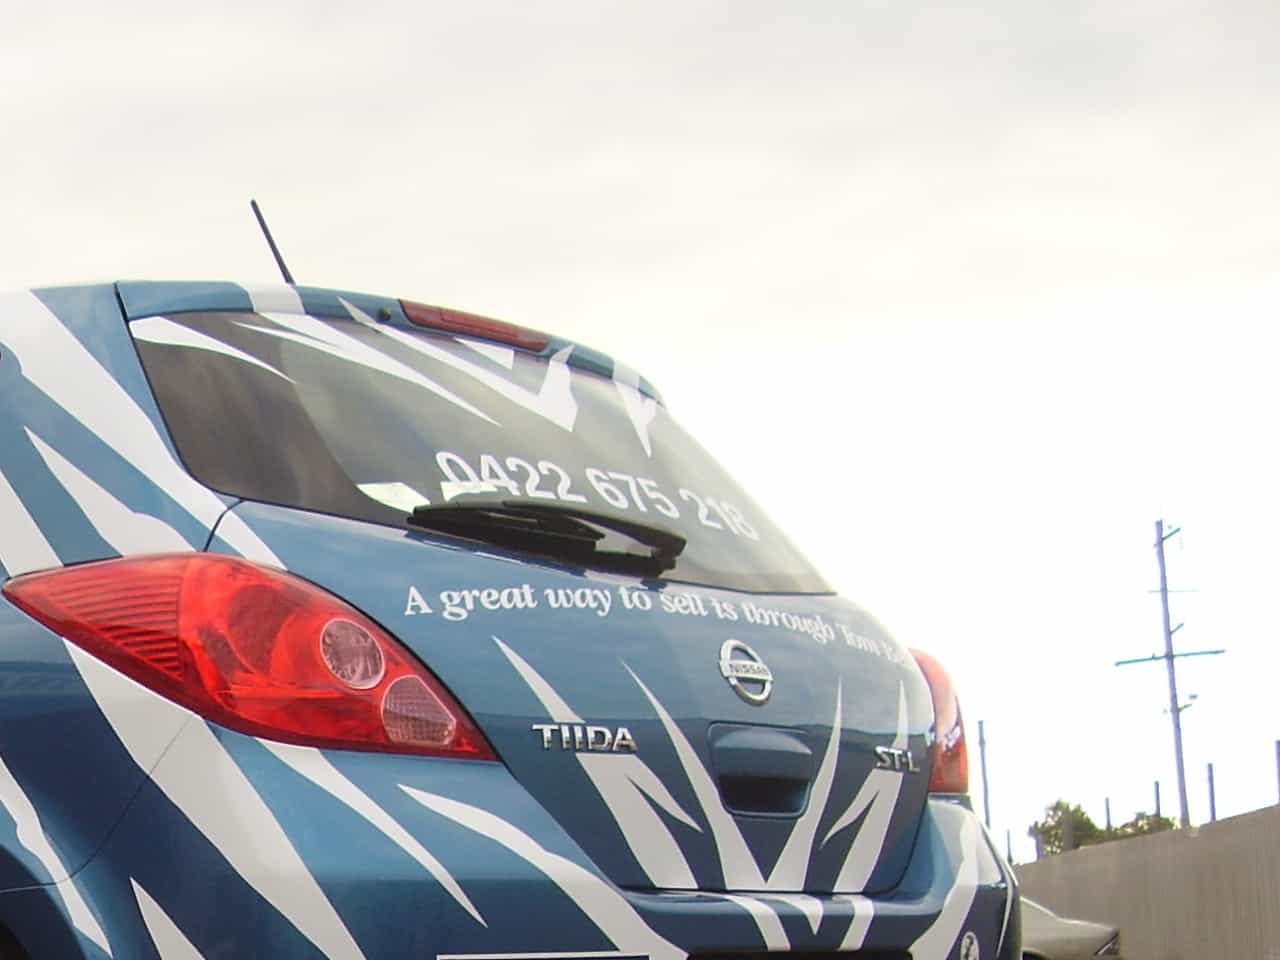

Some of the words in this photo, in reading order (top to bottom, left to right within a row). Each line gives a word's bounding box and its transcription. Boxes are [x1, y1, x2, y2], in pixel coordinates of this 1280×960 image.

[435, 451, 588, 503] 0422
[585, 467, 680, 519] 675
[678, 487, 760, 541] 218
[404, 585, 432, 616] A
[439, 584, 537, 621] great
[543, 586, 612, 616] way
[619, 586, 653, 611] to
[660, 590, 708, 616] sell
[712, 598, 739, 621] is
[741, 601, 836, 644] through
[728, 662, 770, 676] NISSAN
[531, 723, 639, 751] TIIDA
